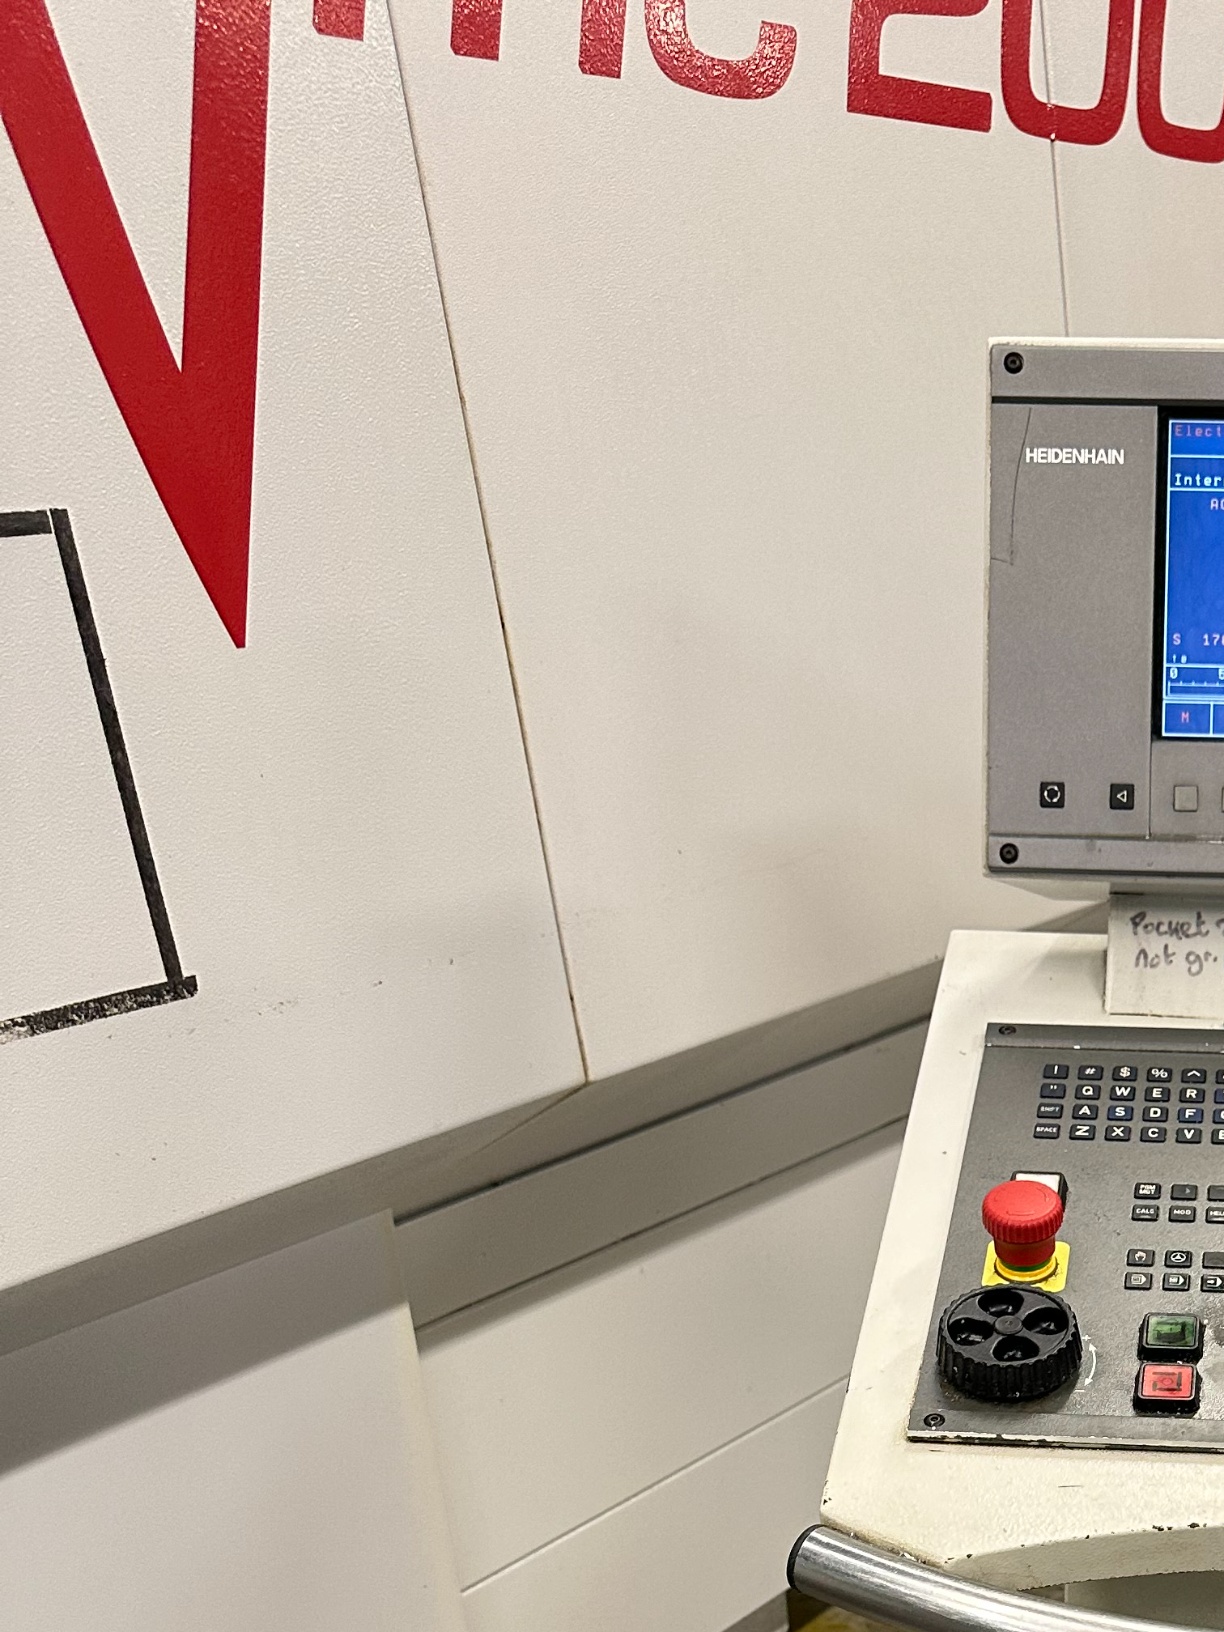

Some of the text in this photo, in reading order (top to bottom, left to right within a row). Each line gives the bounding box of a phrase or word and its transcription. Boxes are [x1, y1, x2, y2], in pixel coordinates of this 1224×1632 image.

[1026, 447, 1125, 464] HEIDENHAIN
[1173, 634, 1181, 645] S
[1181, 711, 1189, 724] M
[1082, 1085, 1094, 1096] Q
[1115, 1086, 1131, 1097] W
[1152, 1088, 1162, 1098] E
[1186, 1088, 1198, 1099] R
[1078, 1106, 1091, 1116] A
[1115, 1107, 1126, 1117] S
[1150, 1108, 1161, 1118] D
[1185, 1109, 1196, 1119] F
[1075, 1126, 1090, 1136] Z
[1112, 1127, 1124, 1137] X
[1148, 1128, 1159, 1138] C
[1183, 1130, 1195, 1139] V
